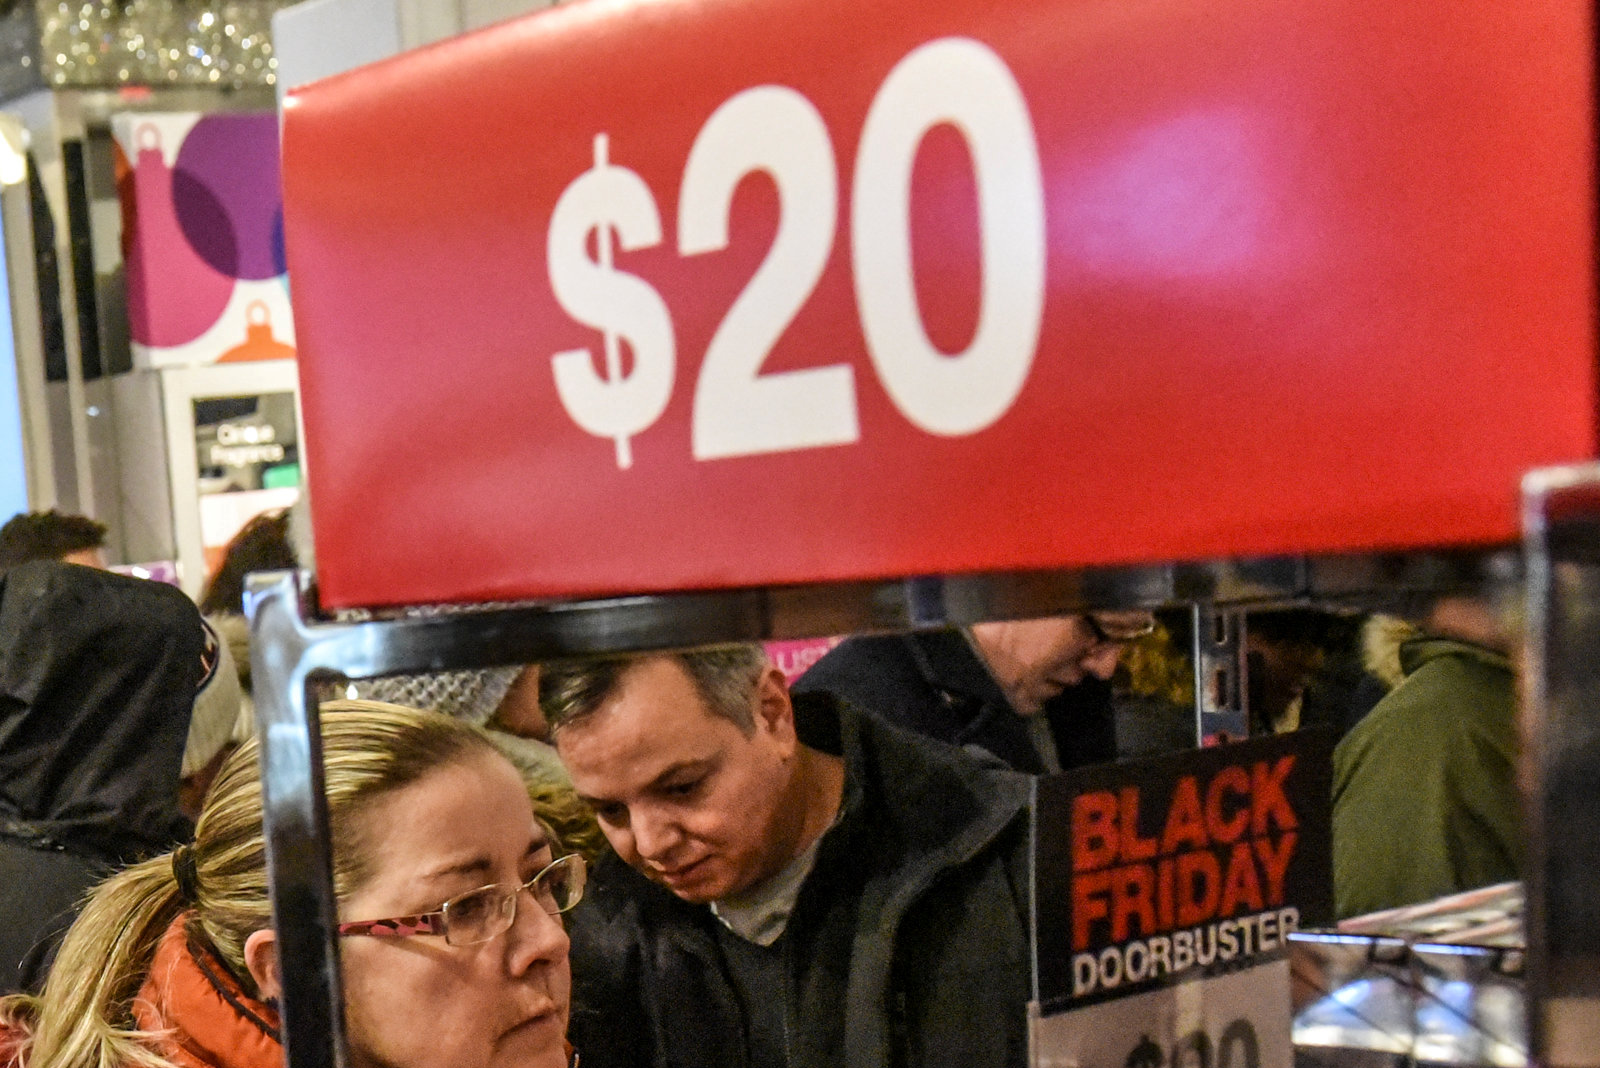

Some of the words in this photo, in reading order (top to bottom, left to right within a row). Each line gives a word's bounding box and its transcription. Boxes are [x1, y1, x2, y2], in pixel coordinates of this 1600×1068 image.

[547, 36, 1046, 469] $20
[1071, 755, 1298, 872] BLACK
[1071, 830, 1298, 951] FRIDAY
[1073, 906, 1299, 997] DOORBUSTER
